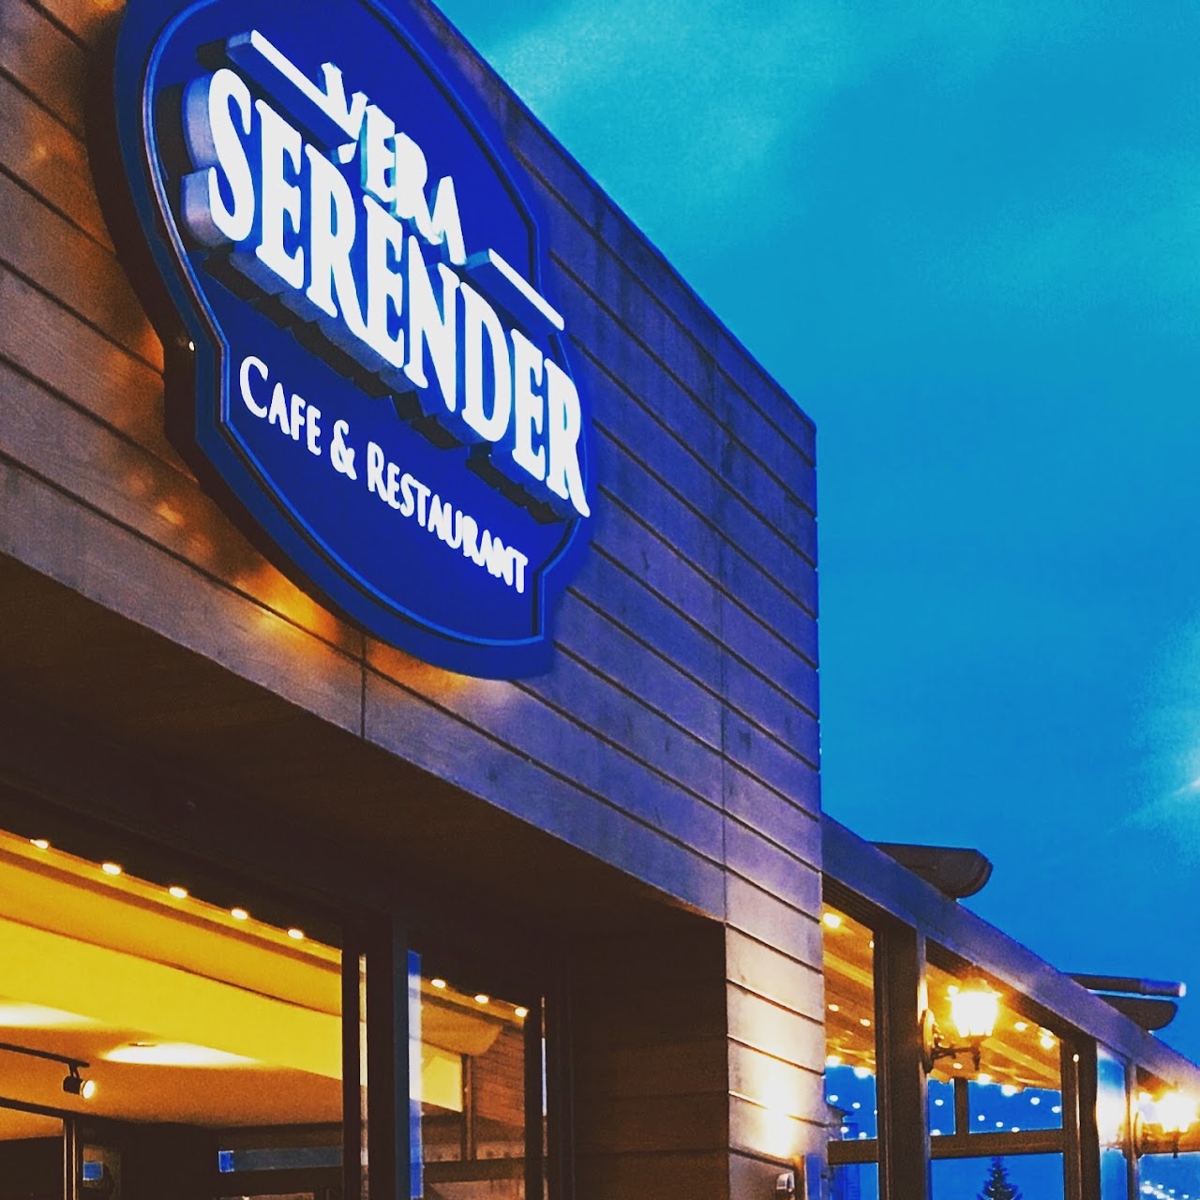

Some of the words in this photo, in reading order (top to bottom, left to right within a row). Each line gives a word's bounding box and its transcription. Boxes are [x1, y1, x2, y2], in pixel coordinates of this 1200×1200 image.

[317, 62, 467, 265] VERA
[206, 68, 591, 518] SERENDER
[239, 355, 322, 456] CAFE
[330, 419, 358, 481] &
[366, 442, 529, 594] RESTAURANT
